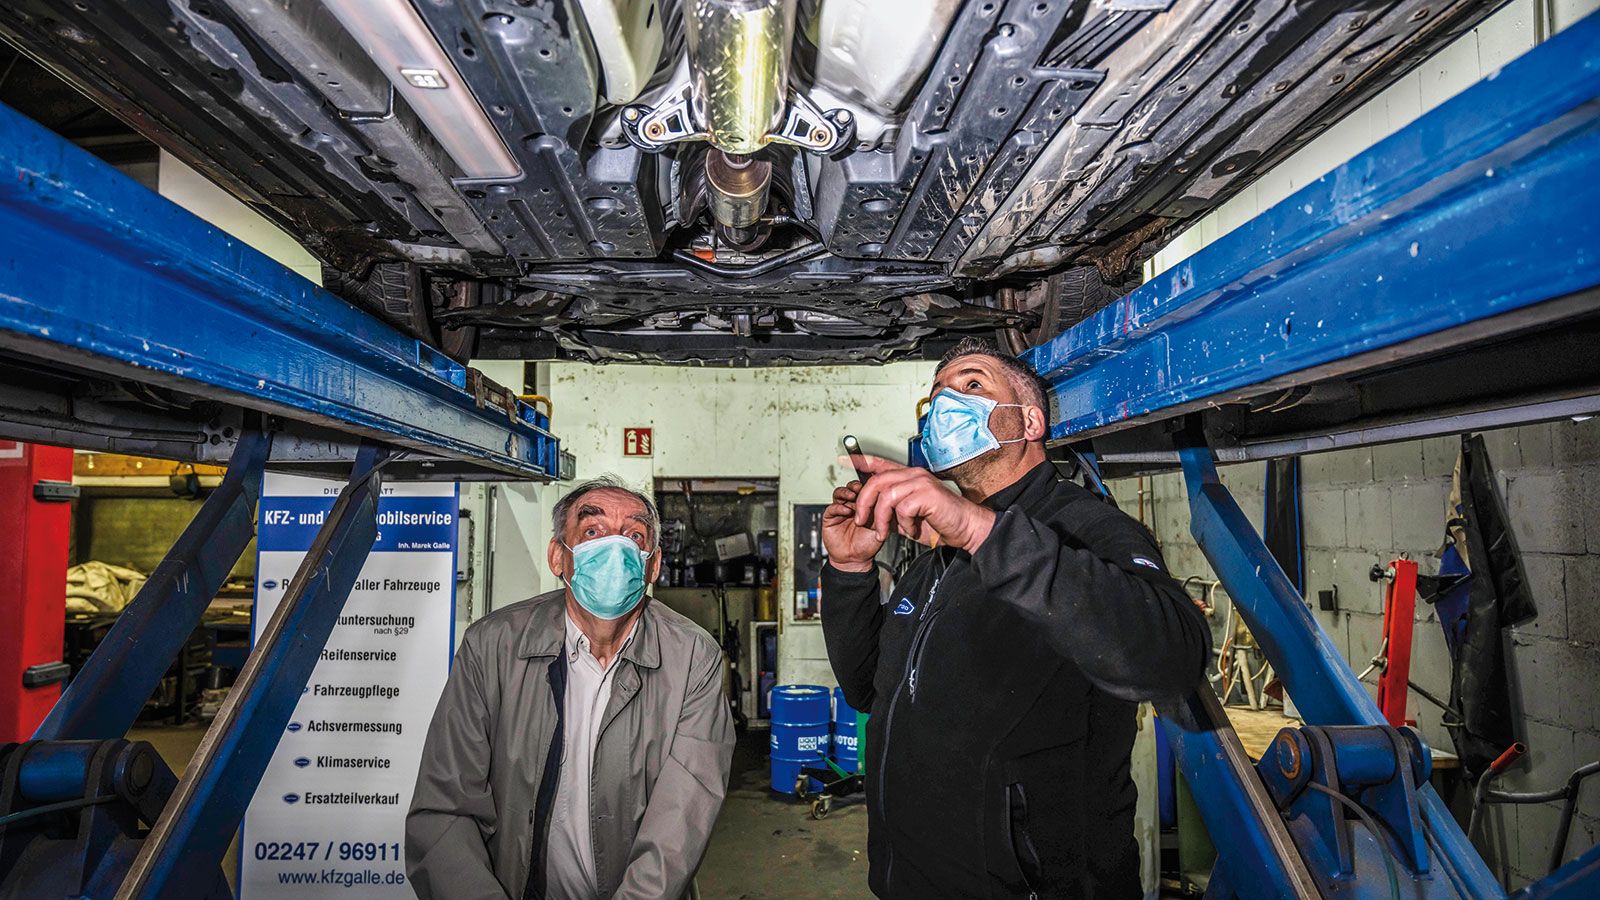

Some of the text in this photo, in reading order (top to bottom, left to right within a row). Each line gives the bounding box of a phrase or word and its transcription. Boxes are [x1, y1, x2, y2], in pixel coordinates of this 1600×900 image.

[264, 510, 452, 525] KFZ- und obilservice
[355, 579, 441, 593] aller Fahrzeuge
[337, 614, 415, 628] tuntersuchung
[373, 627, 409, 636] nach §29
[320, 649, 397, 661] Reifenservice
[314, 684, 400, 699] Fahrzeugpflege
[307, 720, 402, 735] Achsvermessung
[317, 756, 391, 769] Klimaservice
[305, 792, 399, 805] Ersatzteilverkauf
[254, 841, 400, 861] 02247 / 96911
[278, 869, 405, 888] www.kfzgalle.de
